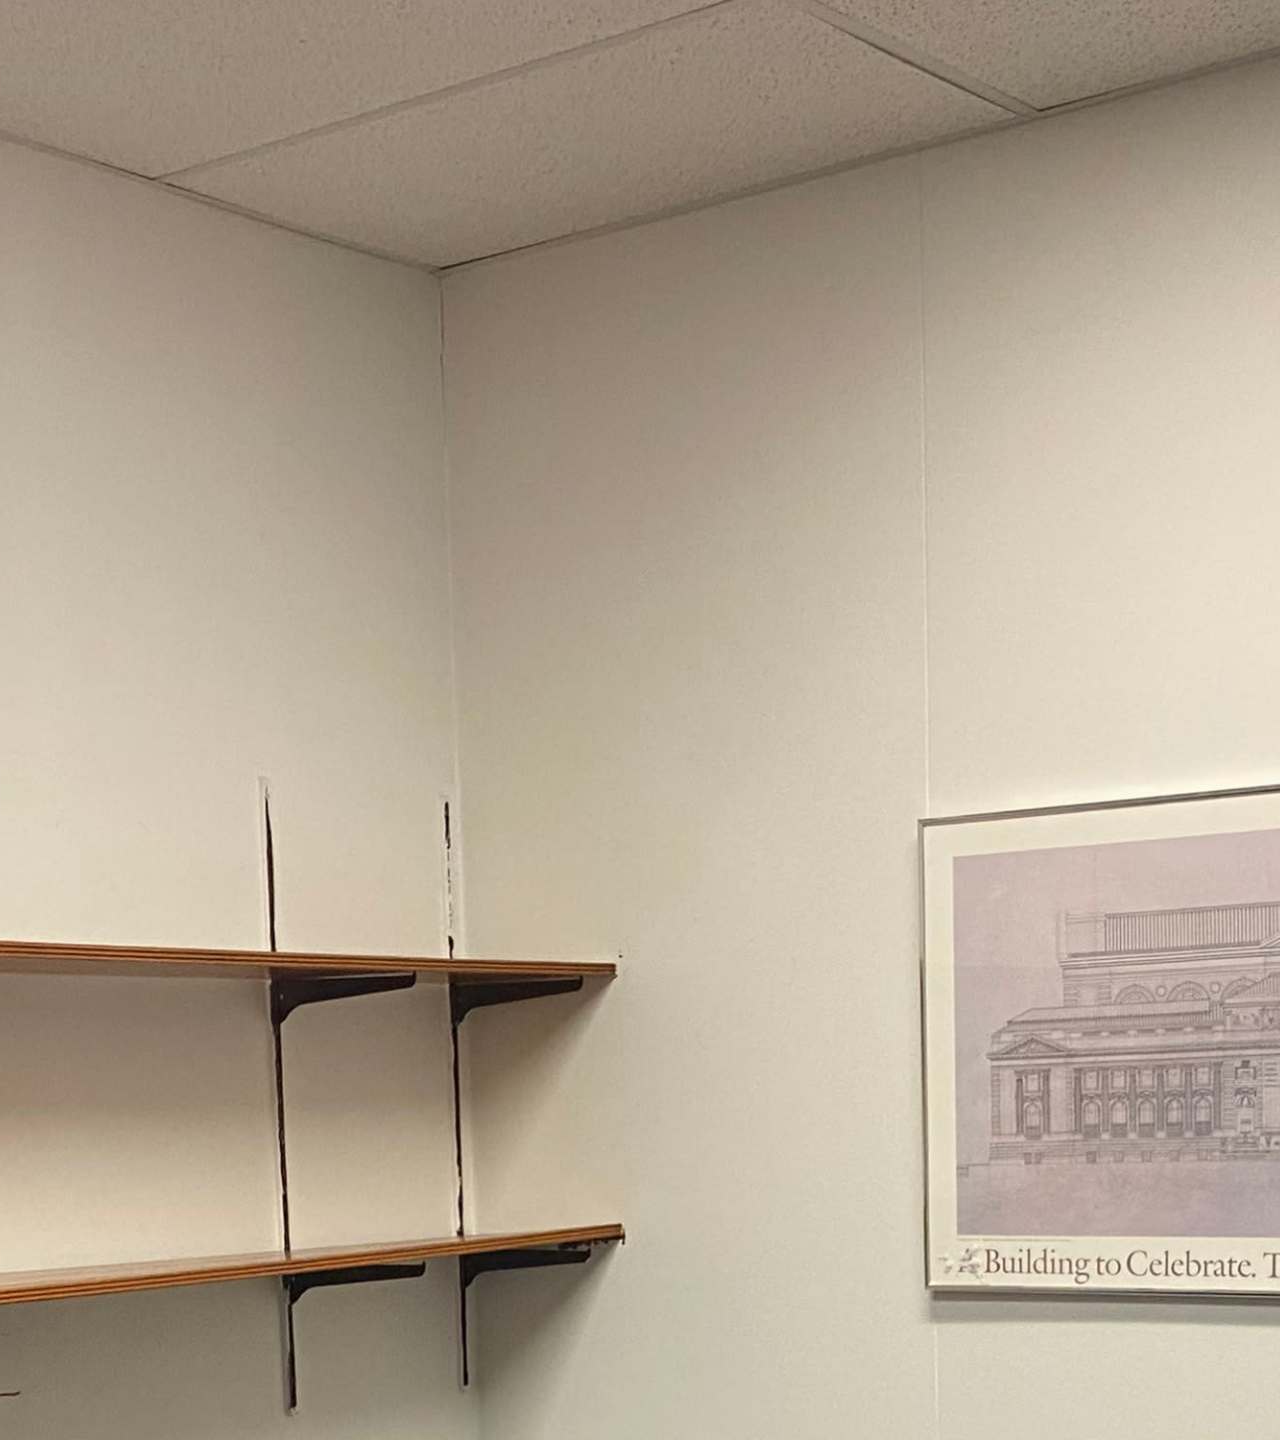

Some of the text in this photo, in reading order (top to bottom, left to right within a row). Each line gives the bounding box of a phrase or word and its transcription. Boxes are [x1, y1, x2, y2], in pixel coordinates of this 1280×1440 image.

[983, 1247, 1091, 1285] Building
[1095, 1255, 1121, 1277] to
[1125, 1249, 1257, 1279] Celebrate.
